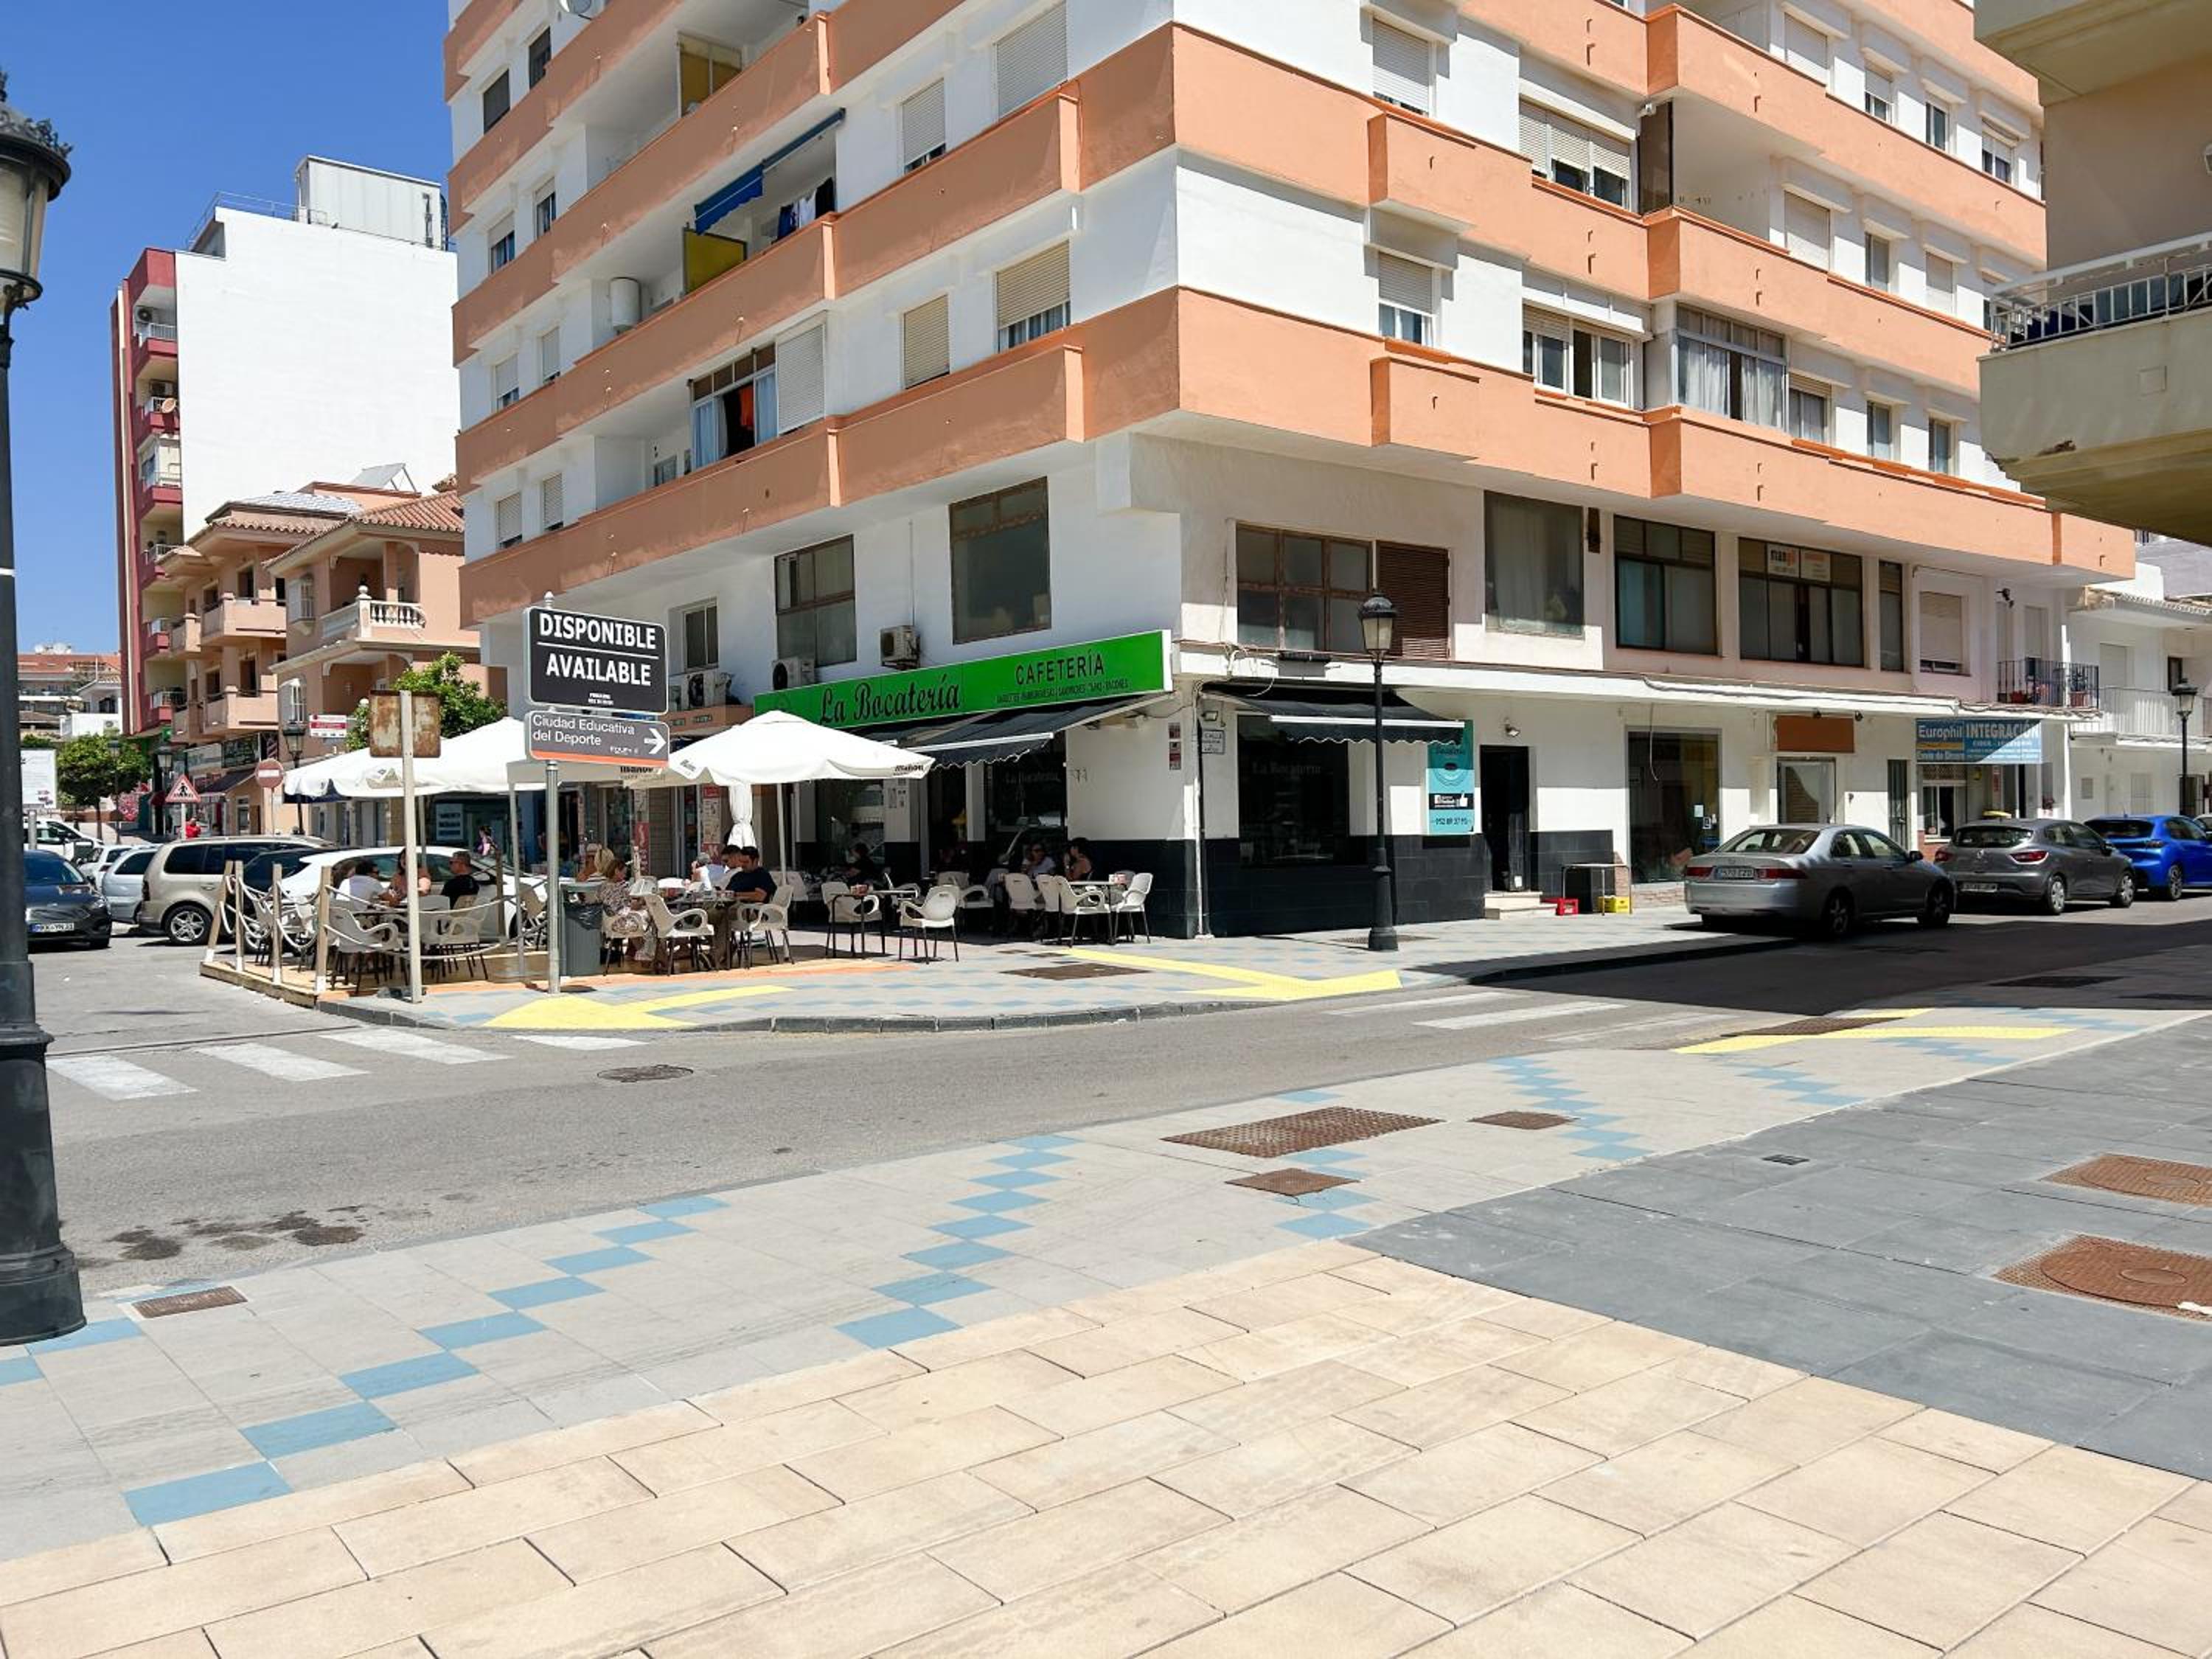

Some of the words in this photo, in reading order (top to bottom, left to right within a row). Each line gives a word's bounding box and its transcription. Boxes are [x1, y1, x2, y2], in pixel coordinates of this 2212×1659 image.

[539, 613, 656, 650] DISPONIBLE
[546, 653, 651, 686] AVAILABLE
[1015, 649, 1105, 685] CAFETERÍA
[820, 688, 846, 725] La
[853, 674, 959, 720] Bocatería
[532, 714, 575, 730] Ciudad
[579, 719, 635, 735] Educativa
[533, 729, 551, 742] del
[554, 731, 602, 746] Deporte
